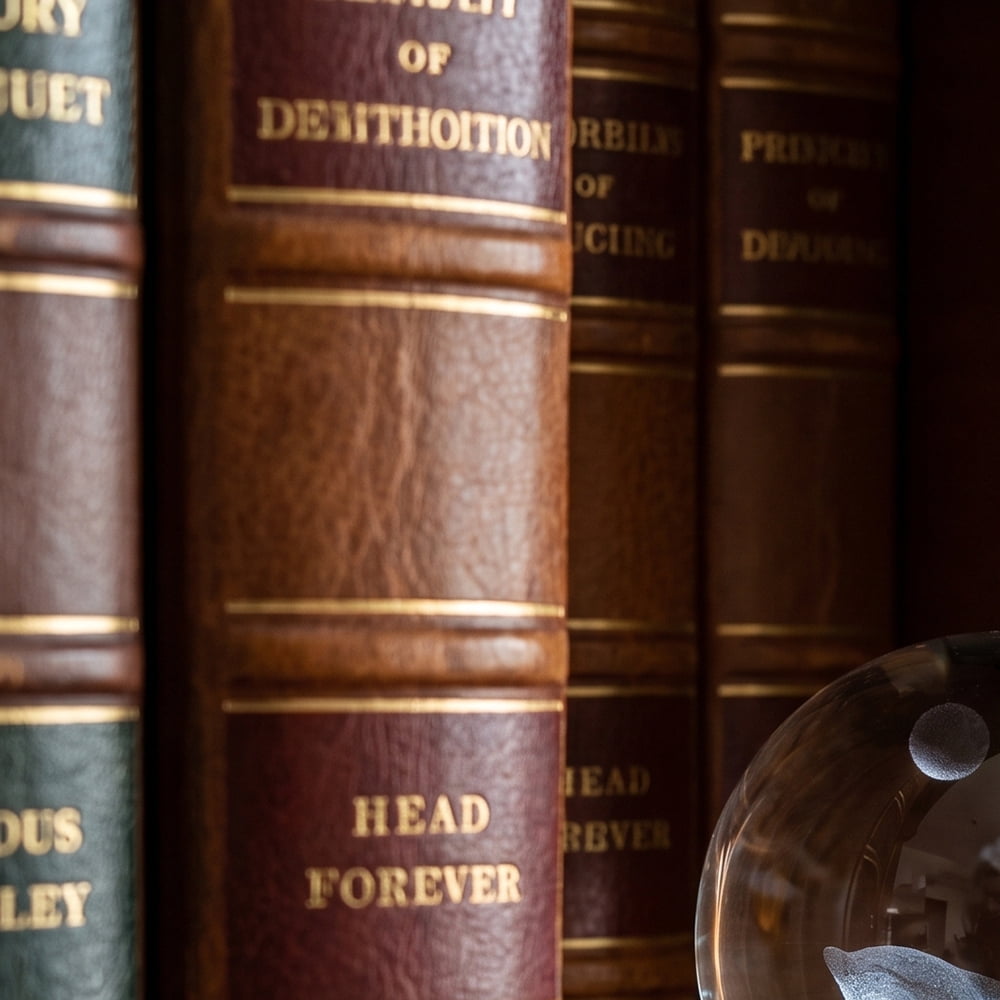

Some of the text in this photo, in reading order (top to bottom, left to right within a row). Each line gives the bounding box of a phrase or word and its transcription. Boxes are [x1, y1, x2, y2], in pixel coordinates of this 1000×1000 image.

[398, 39, 451, 75] OF
[0, 67, 111, 126] UET
[574, 173, 615, 199] OF
[352, 794, 490, 838] HEAD
[305, 864, 522, 909] FOREVER
